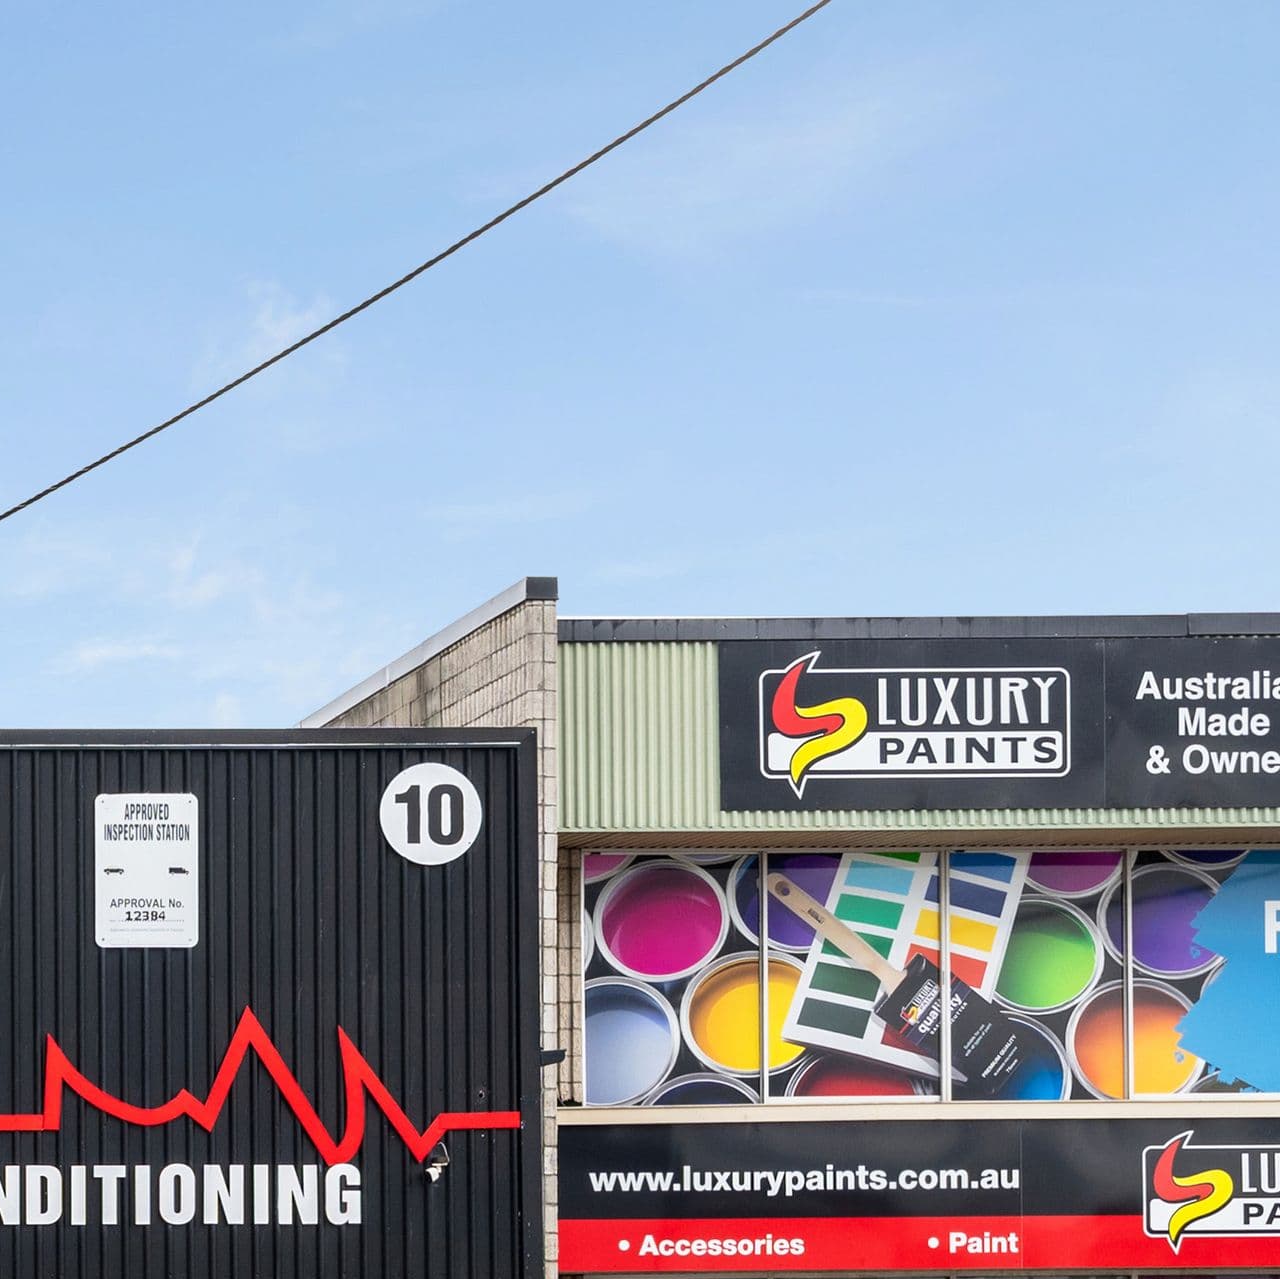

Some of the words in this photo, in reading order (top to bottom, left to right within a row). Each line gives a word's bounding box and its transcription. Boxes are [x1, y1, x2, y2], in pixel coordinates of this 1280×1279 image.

[877, 676, 1057, 726] LUXURY
[1178, 707, 1270, 736] Made
[878, 736, 1058, 765] PAINTS
[1146, 745, 1171, 774] &
[124, 803, 169, 821] APPROVED
[394, 782, 465, 847] 10
[104, 824, 154, 841] INSPECTION
[155, 824, 190, 841] STATION
[110, 899, 165, 909] APPROVAL
[168, 899, 185, 909] No.
[125, 911, 166, 921] 12384
[589, 1164, 1020, 1197] www.luxurypaints.com.au
[638, 1234, 805, 1256] Accessories
[948, 1232, 1019, 1255] Paint
